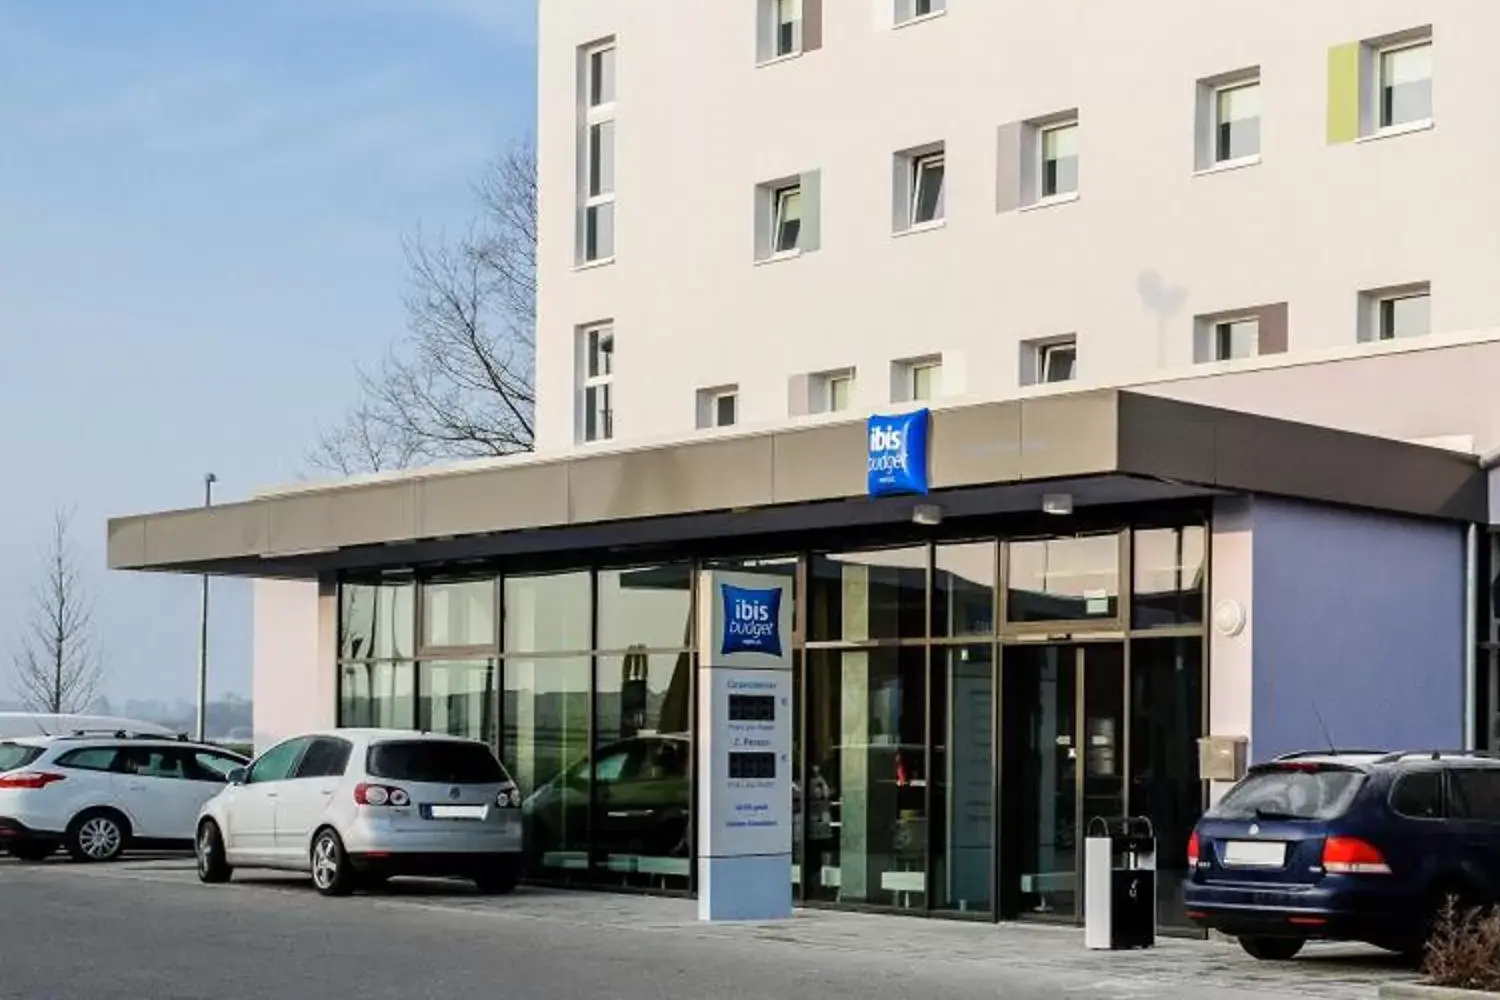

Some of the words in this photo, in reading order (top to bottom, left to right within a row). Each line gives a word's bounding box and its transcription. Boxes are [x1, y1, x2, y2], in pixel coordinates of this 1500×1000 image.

[870, 425, 901, 452] ibis
[868, 451, 908, 475] budget
[735, 599, 769, 621] ibis
[729, 620, 774, 639] budget
